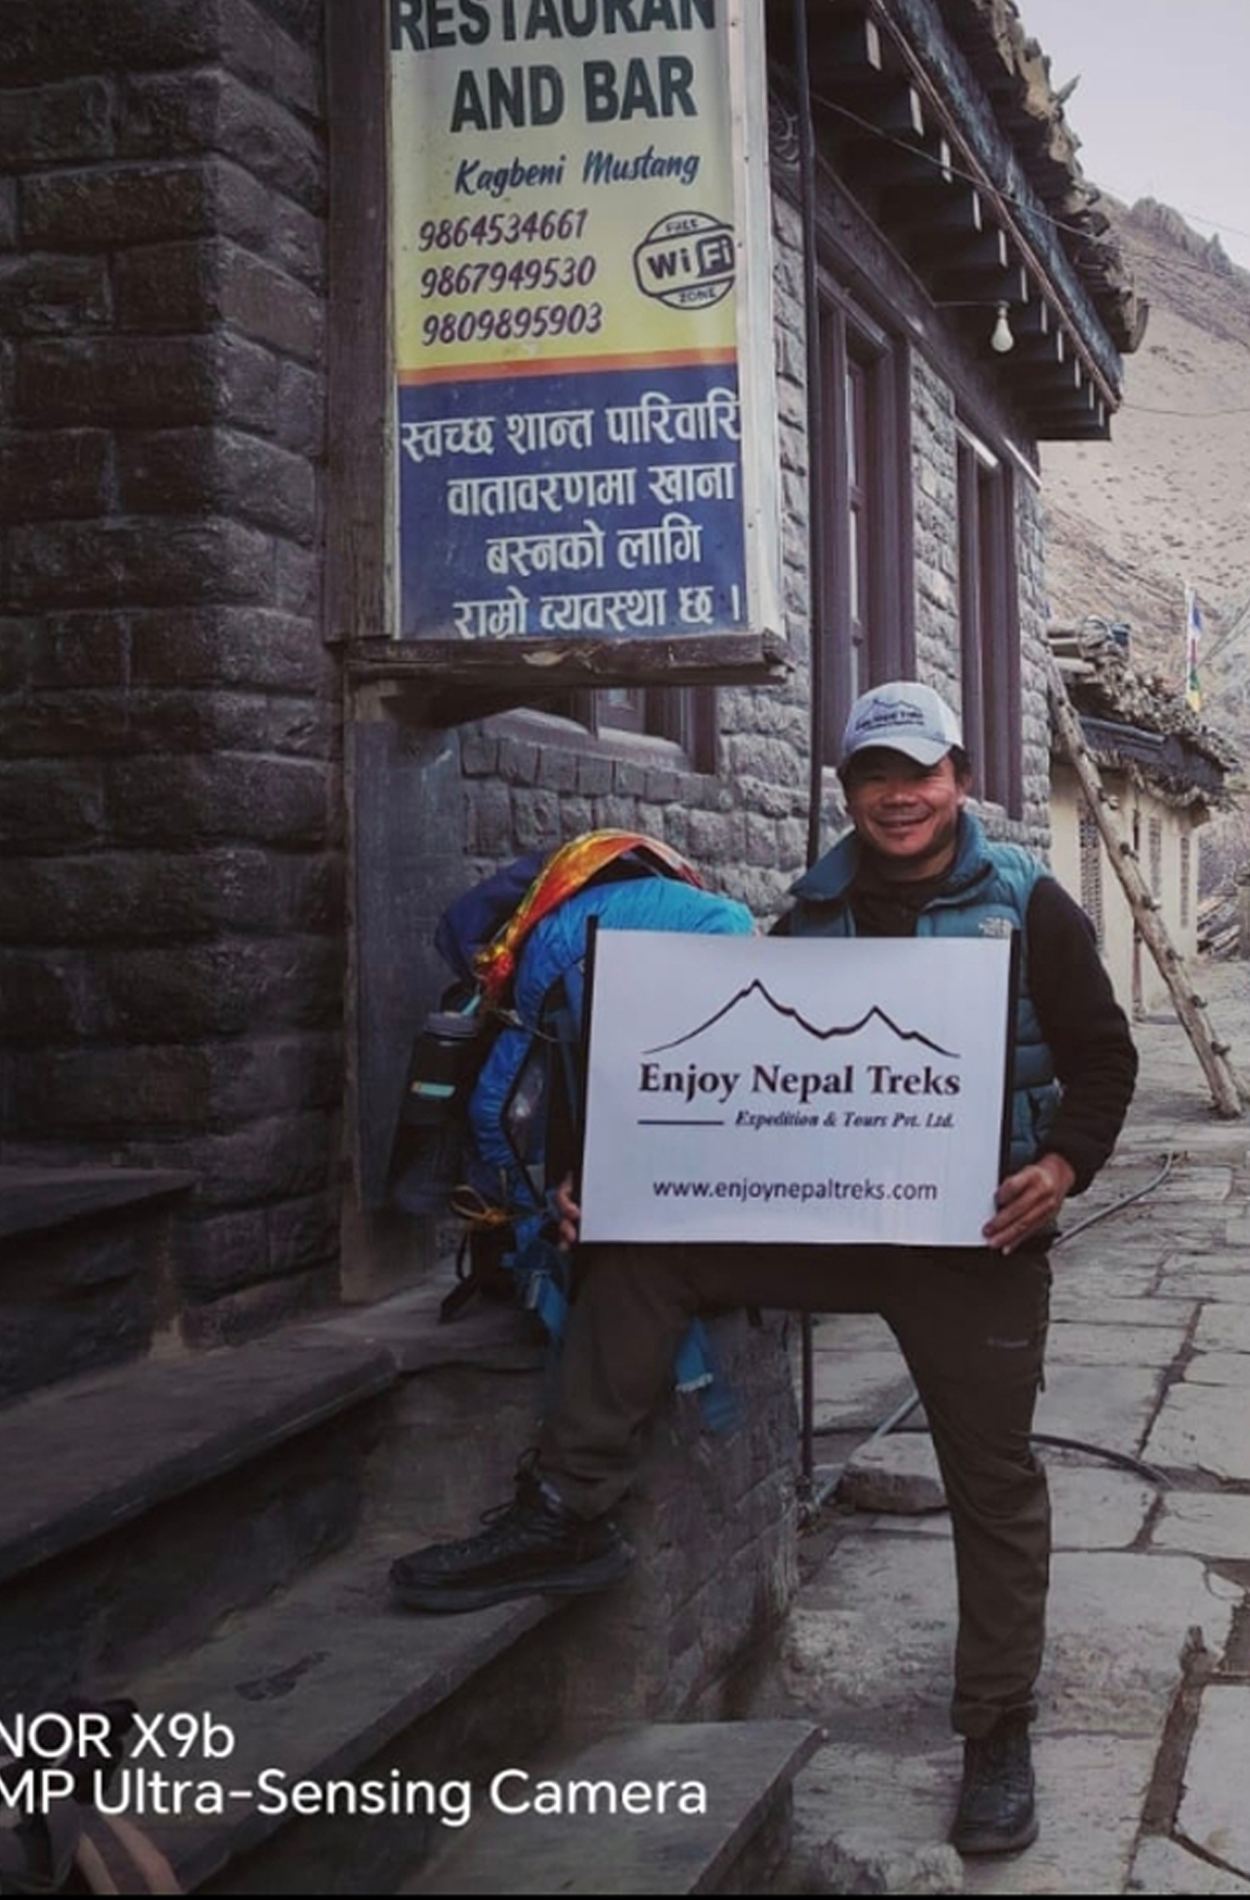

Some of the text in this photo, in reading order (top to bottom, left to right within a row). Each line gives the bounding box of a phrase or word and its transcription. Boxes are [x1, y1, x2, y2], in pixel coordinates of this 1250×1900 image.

[450, 55, 698, 133] AND BAR
[454, 145, 701, 198] Kagbeni Mustang
[418, 208, 589, 252] 9864534661
[420, 256, 597, 299] 9867949530
[422, 302, 604, 347] 9809895903
[401, 416, 496, 463] स्वच्छ
[507, 408, 594, 456] शान्त
[447, 461, 736, 517] वातावरणमा खाना
[486, 512, 703, 577] बस्नको लागि
[540, 589, 667, 632] व्यवस्था
[638, 1063, 961, 1103] Enjoy Nepal Treks
[734, 1110, 955, 1131] Expedition & Tours Pvt. Ltd.
[652, 1177, 938, 1203] www.enjoynepaltreks.com
